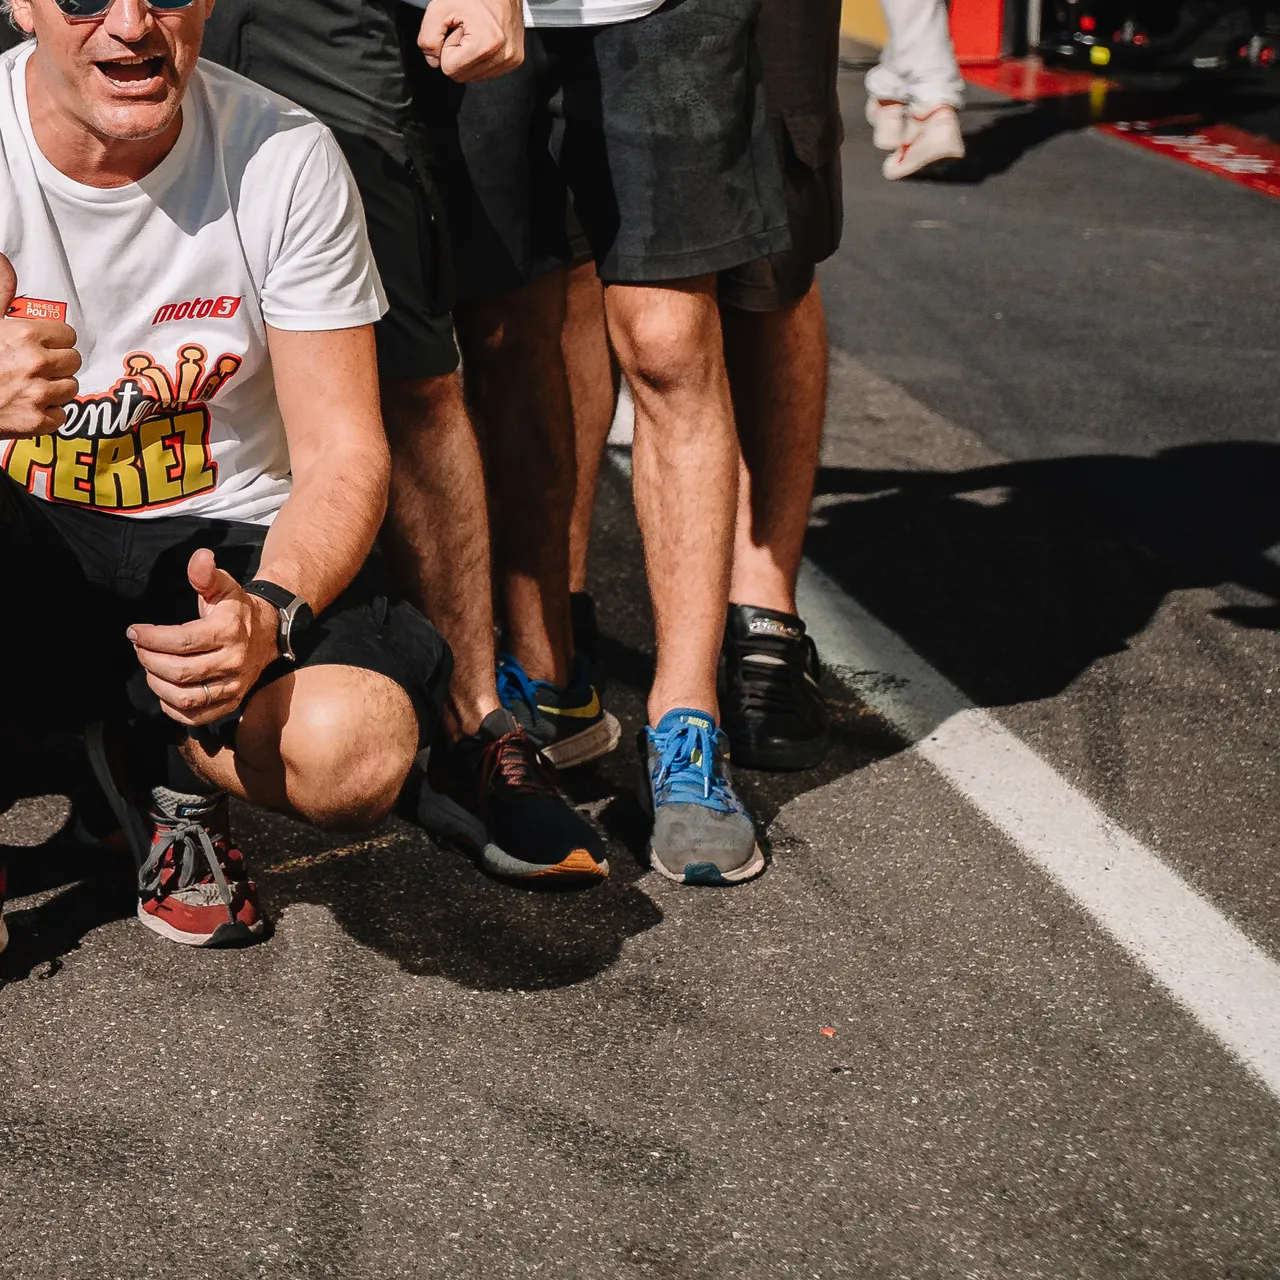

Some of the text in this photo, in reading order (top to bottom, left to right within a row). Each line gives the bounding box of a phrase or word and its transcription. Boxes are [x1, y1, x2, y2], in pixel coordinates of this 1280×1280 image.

[26, 308, 61, 319] POLITO
[27, 301, 61, 313] 2 WHEELS
[152, 295, 242, 326] moto3
[8, 411, 215, 508] PEREZ
